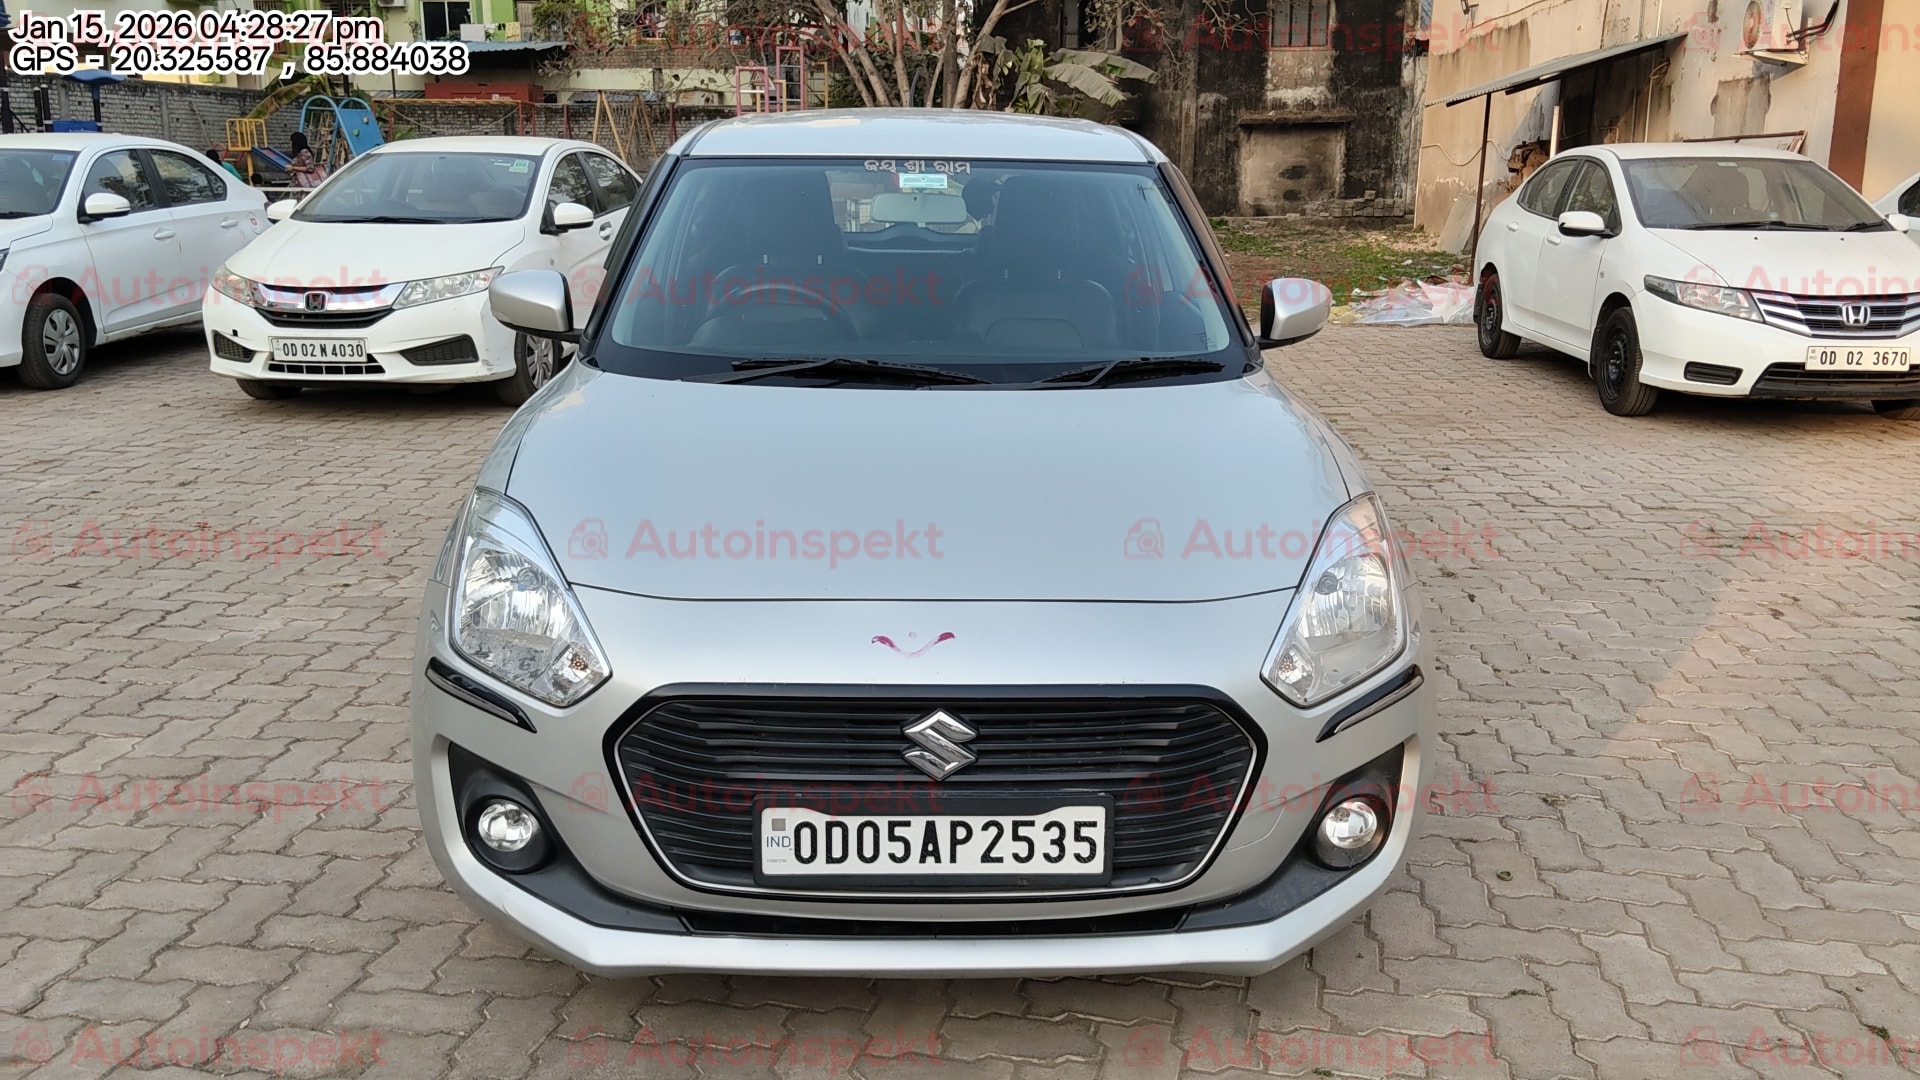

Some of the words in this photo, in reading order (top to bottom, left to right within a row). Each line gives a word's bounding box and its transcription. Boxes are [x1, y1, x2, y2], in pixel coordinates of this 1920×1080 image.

[283, 343, 298, 357] OD
[301, 343, 317, 357] 02
[331, 343, 364, 358] 4030
[1820, 351, 1837, 365] OD
[1846, 351, 1863, 366] 02
[1872, 351, 1908, 366] 3670
[766, 835, 791, 848] IND
[793, 820, 1098, 865] OD05AP2535
